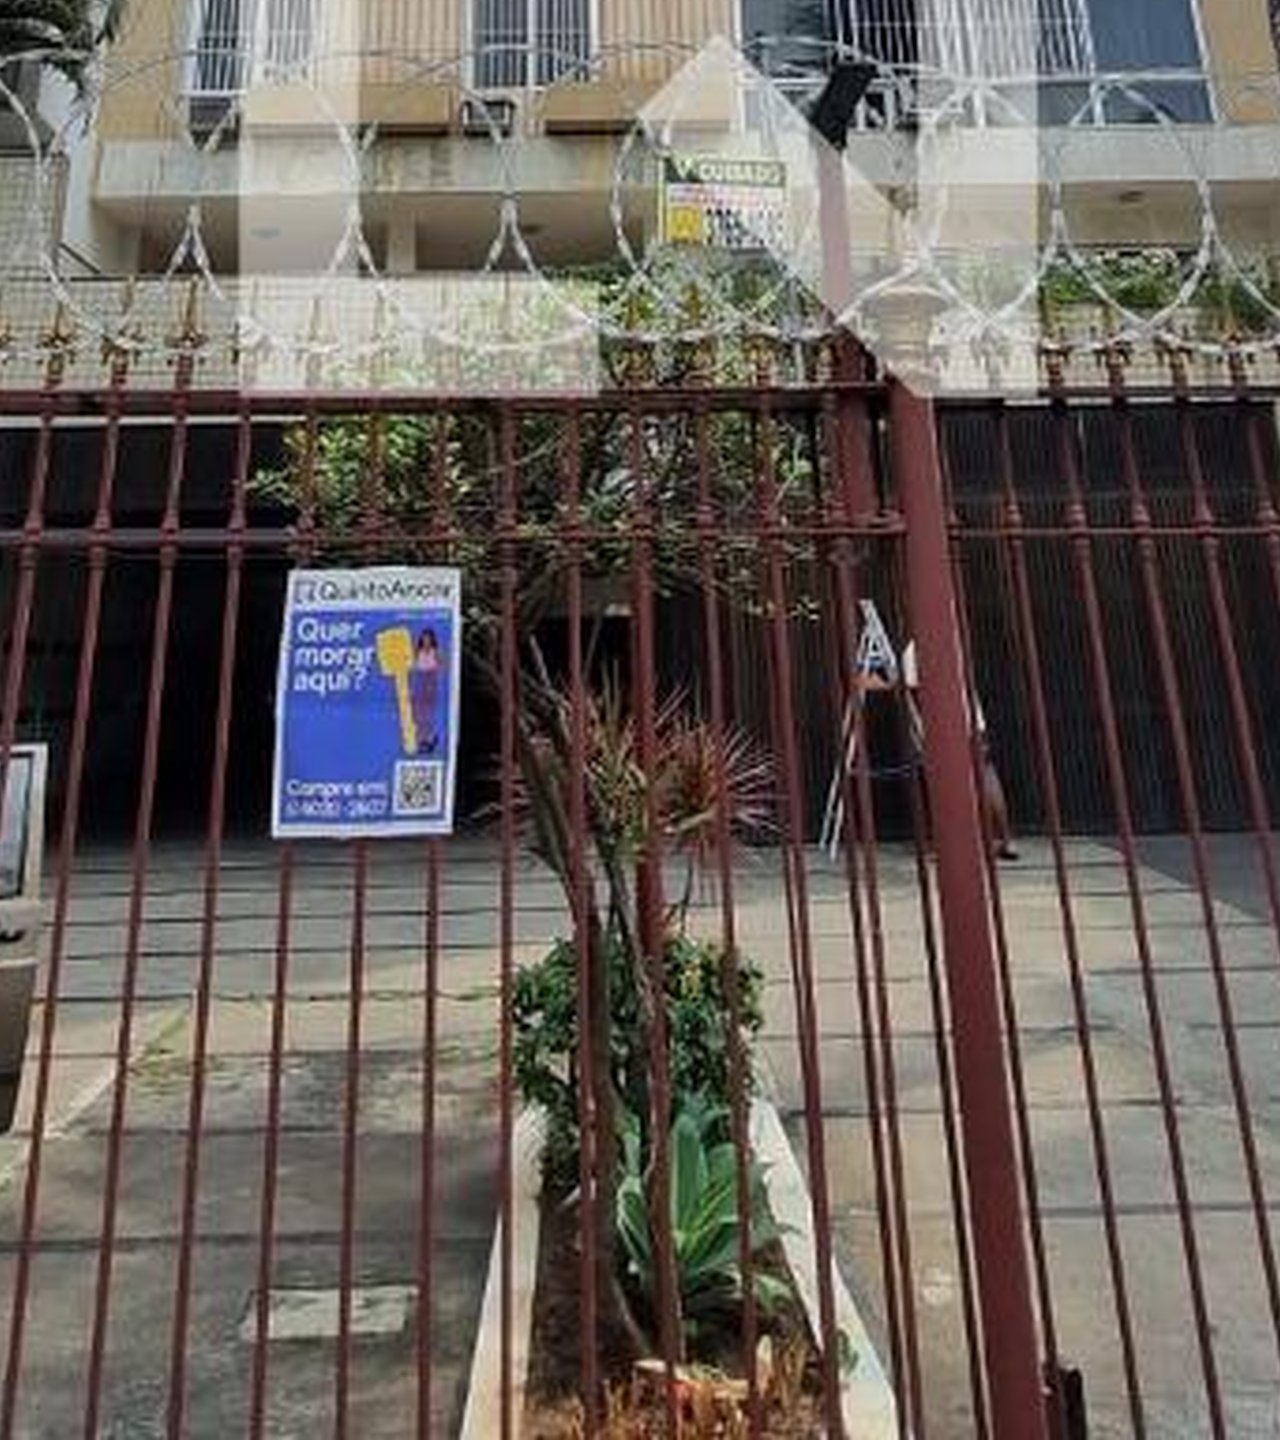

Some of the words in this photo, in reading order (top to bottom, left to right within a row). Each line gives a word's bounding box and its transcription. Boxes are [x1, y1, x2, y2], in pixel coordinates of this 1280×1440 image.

[320, 580, 451, 601] QuintoAndar
[296, 617, 365, 643] Quer
[293, 646, 375, 666] morar
[293, 666, 368, 697] aqui?
